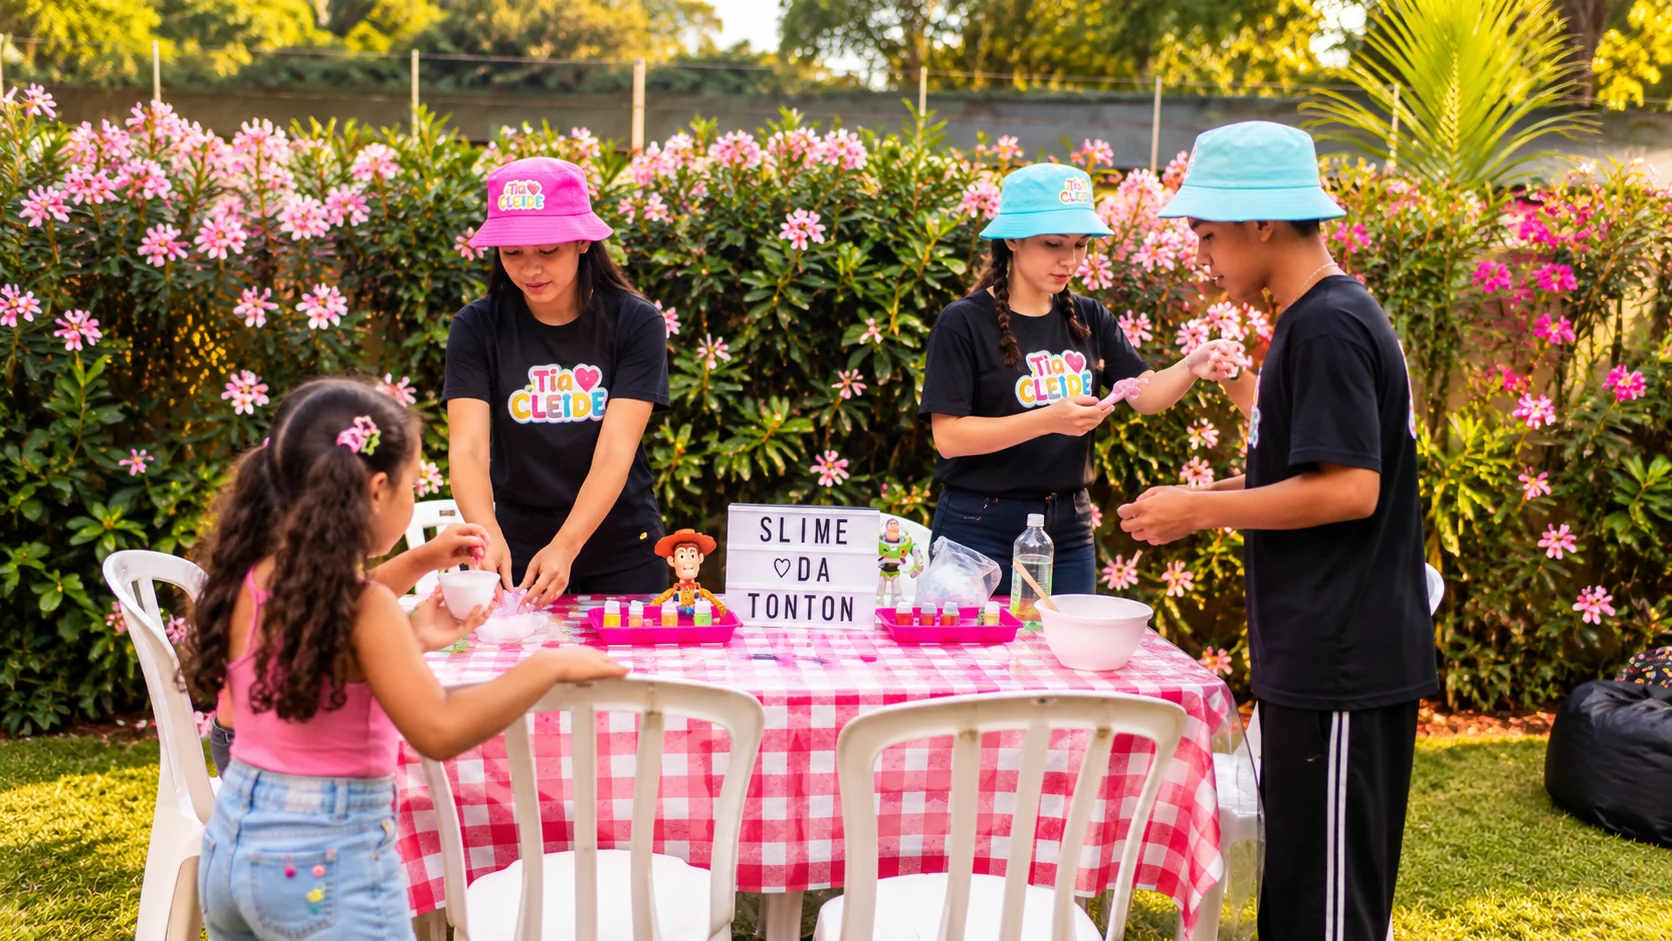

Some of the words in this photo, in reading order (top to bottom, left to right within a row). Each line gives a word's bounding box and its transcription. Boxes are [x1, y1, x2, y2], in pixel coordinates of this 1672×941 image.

[499, 195, 544, 209] CLEIDE
[1030, 355, 1065, 377] Tia
[533, 368, 573, 393] Tia
[1019, 373, 1091, 403] CLEIDE
[511, 391, 606, 420] CLEIDE
[760, 516, 848, 545] SLIME
[797, 556, 830, 583] DA
[747, 592, 854, 622] TONTON
